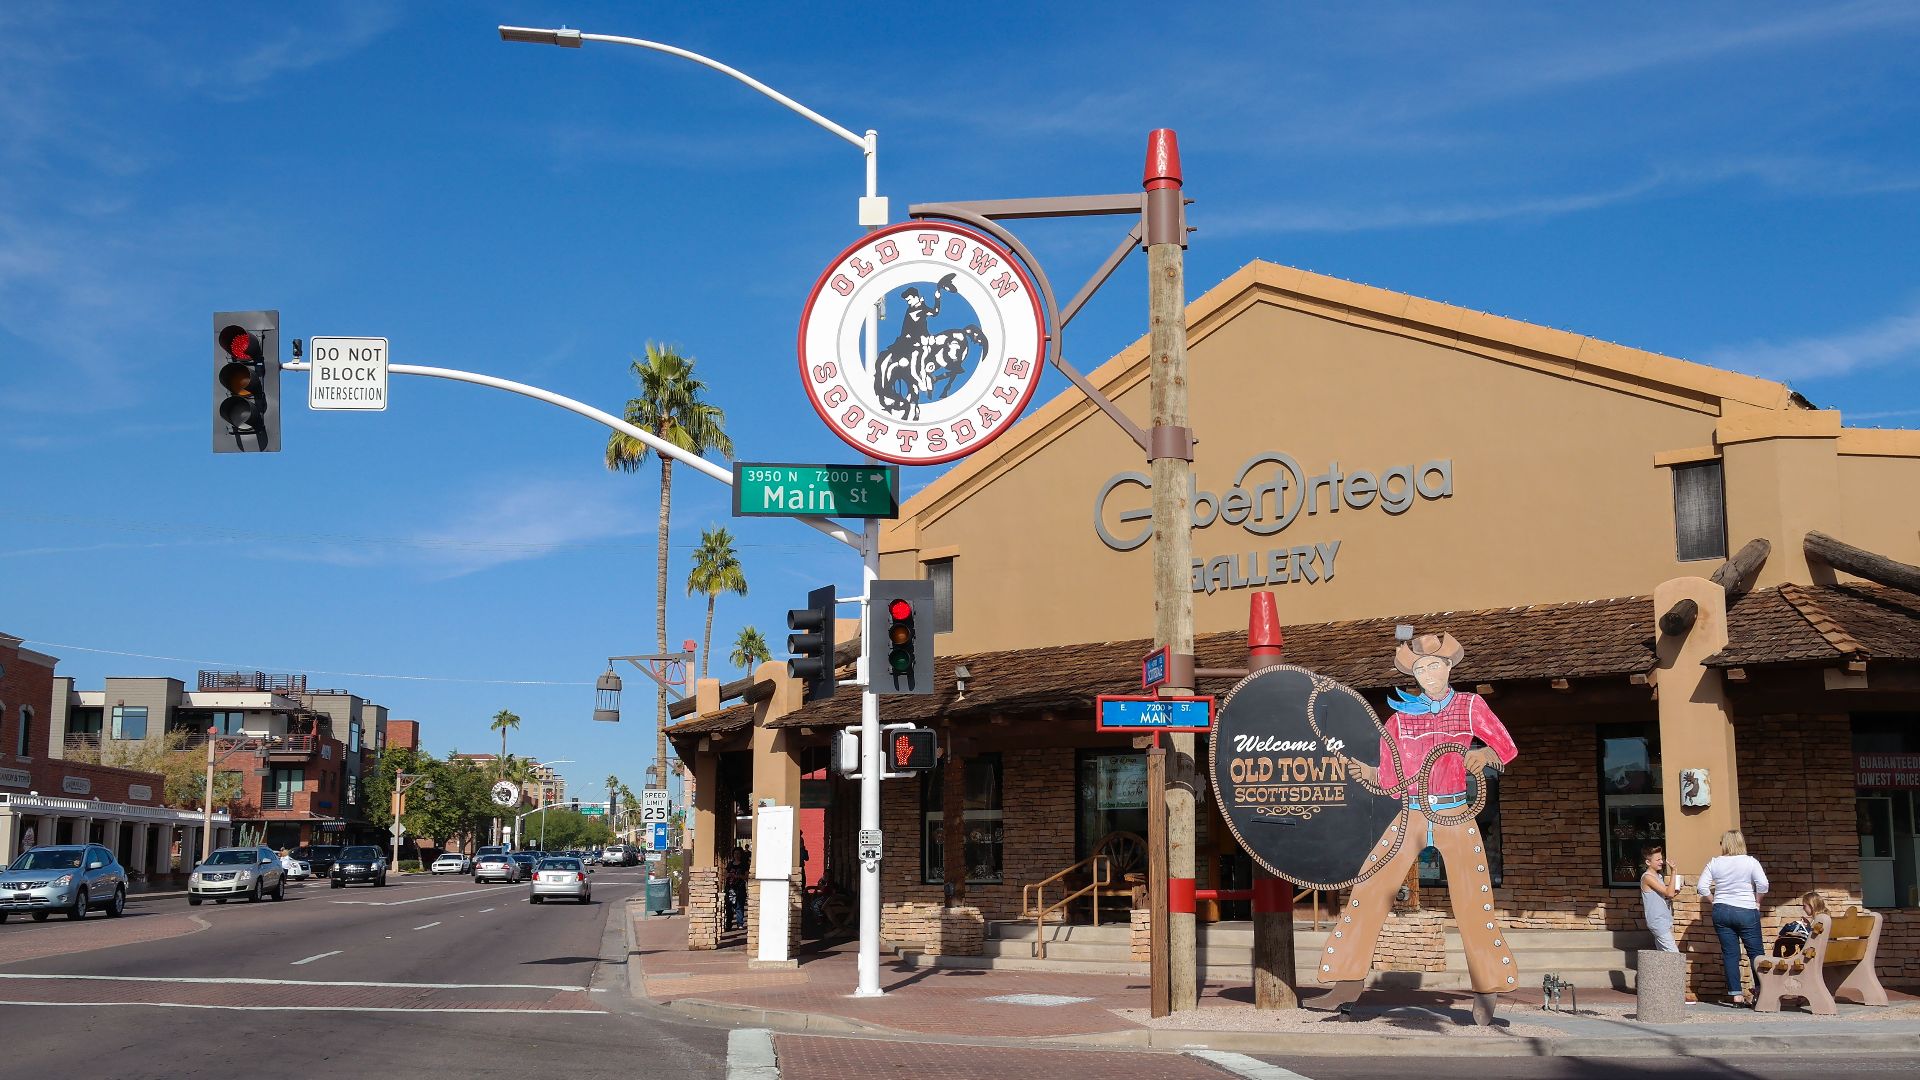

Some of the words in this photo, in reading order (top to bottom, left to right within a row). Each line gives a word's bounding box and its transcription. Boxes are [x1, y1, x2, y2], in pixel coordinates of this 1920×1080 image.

[831, 239, 900, 297] OLD
[918, 233, 1019, 298] TOWN
[316, 347, 340, 361] DO
[348, 347, 382, 362] NOT
[321, 367, 377, 381] BLOCK
[314, 386, 382, 401] INTERSECTION
[813, 357, 1030, 453] SCOTTSDALE
[747, 470, 782, 482] 3950
[788, 471, 798, 482] N
[815, 471, 849, 483] 7200
[855, 473, 863, 483] E
[763, 484, 835, 510] Main
[849, 488, 868, 503] St
[1120, 704, 1128, 712] E.
[1146, 703, 1165, 712] 7200
[1180, 704, 1192, 712] ST.
[1140, 711, 1173, 724] MAIN
[1233, 734, 1317, 753] Welcome
[1326, 736, 1346, 752] to
[1230, 756, 1274, 783] OLD
[1277, 756, 1349, 783] TOWN
[1856, 772, 1891, 786] LOWEST
[1234, 786, 1345, 802] SCOTTSDALE
[644, 807, 666, 820] 25
